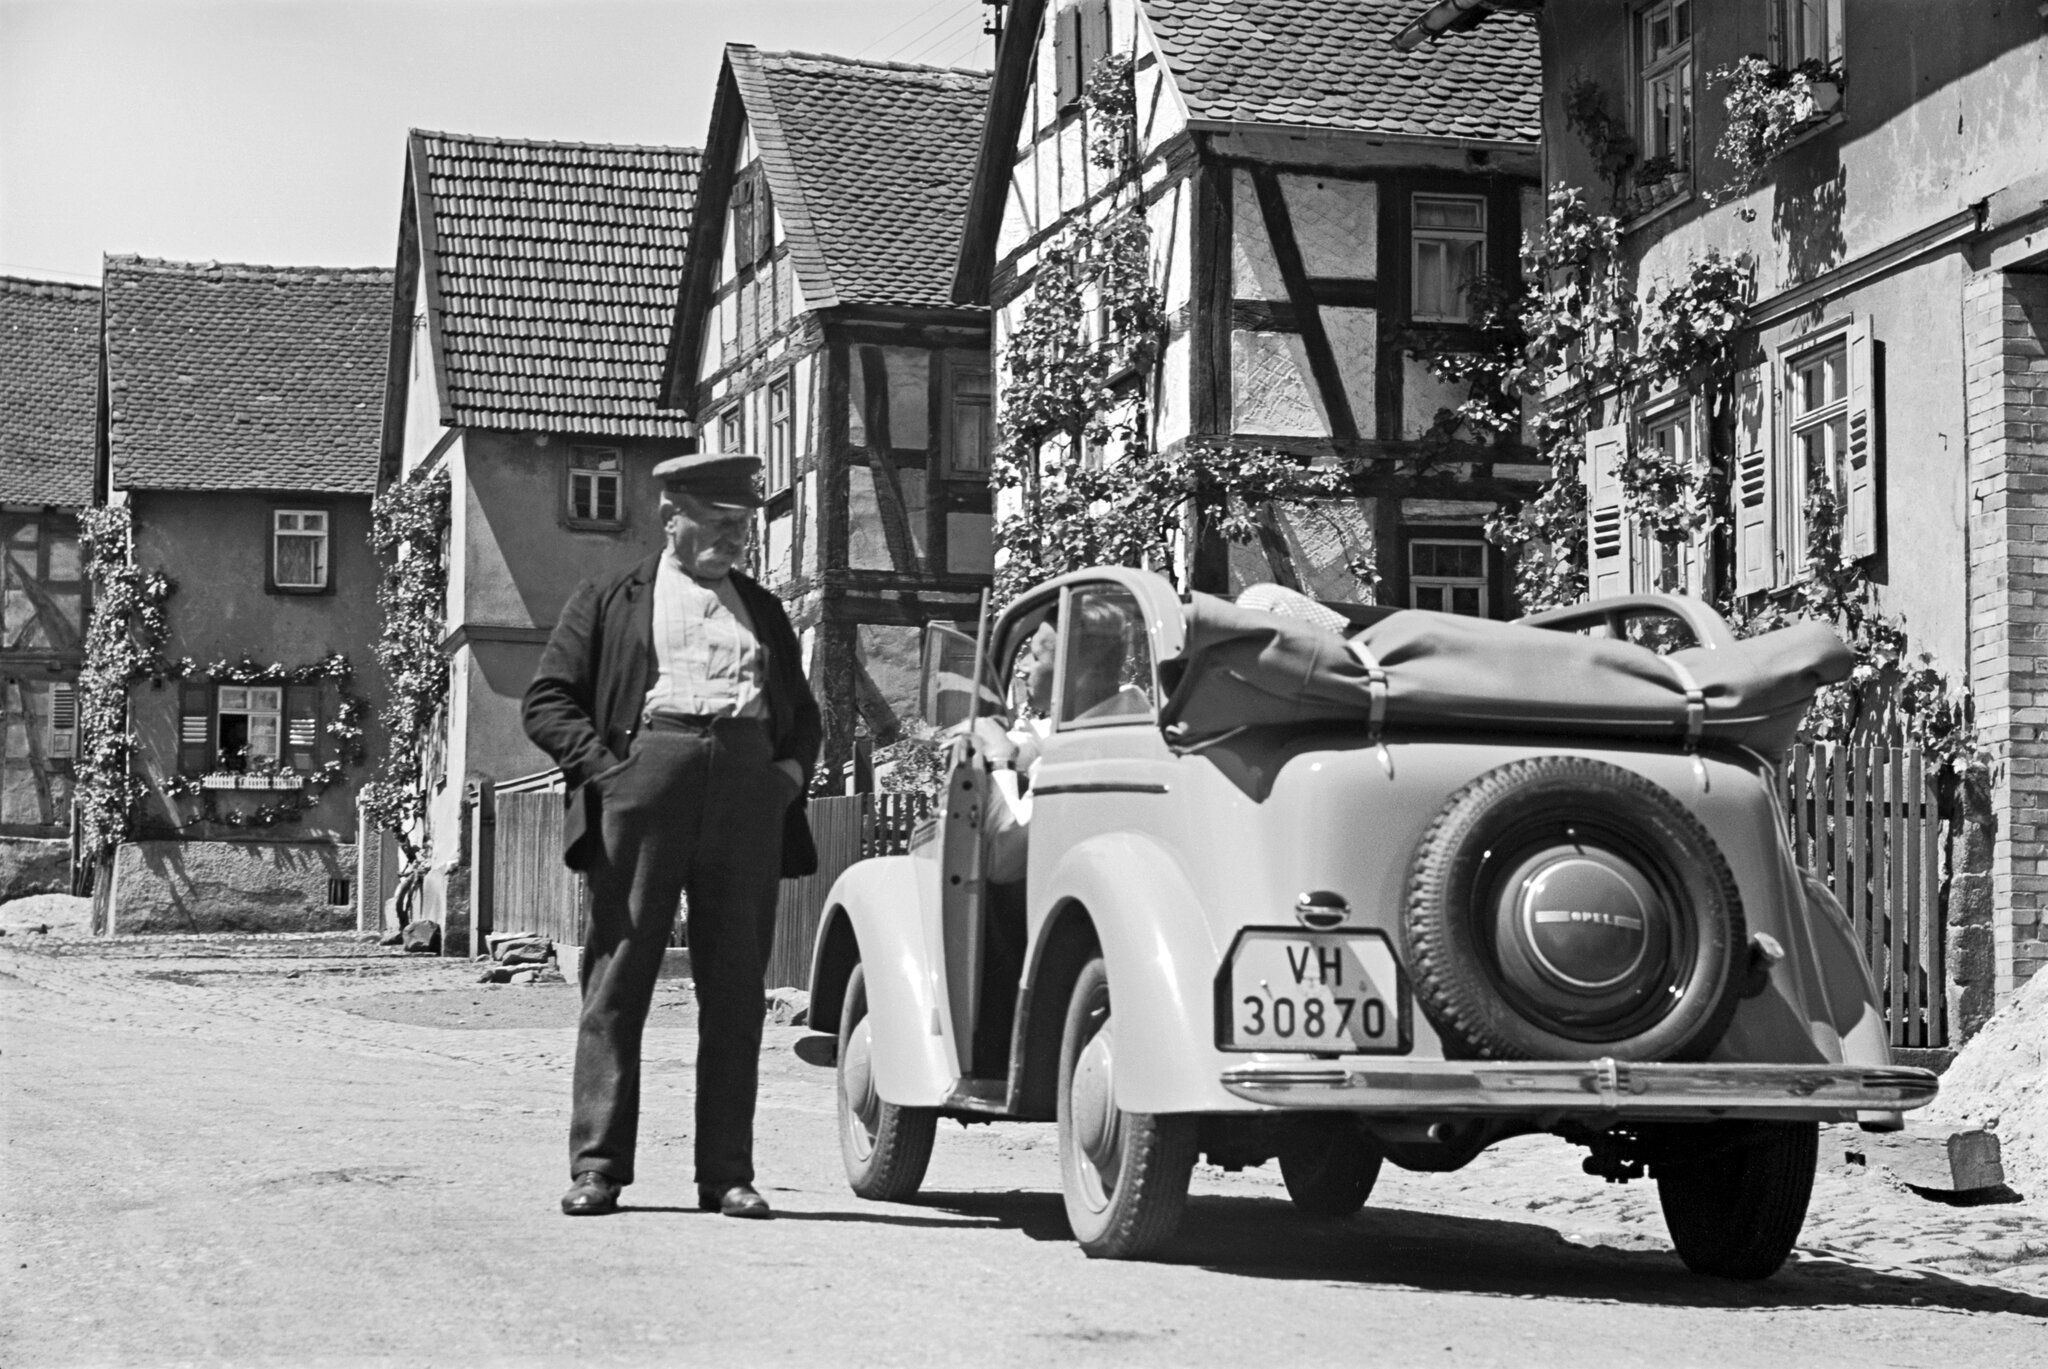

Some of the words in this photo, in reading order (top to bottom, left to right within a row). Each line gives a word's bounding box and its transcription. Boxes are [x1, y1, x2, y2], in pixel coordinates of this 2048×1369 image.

[1571, 911, 1613, 925] OPEL
[1286, 945, 1342, 986] VH
[1242, 995, 1386, 1038] 30870
